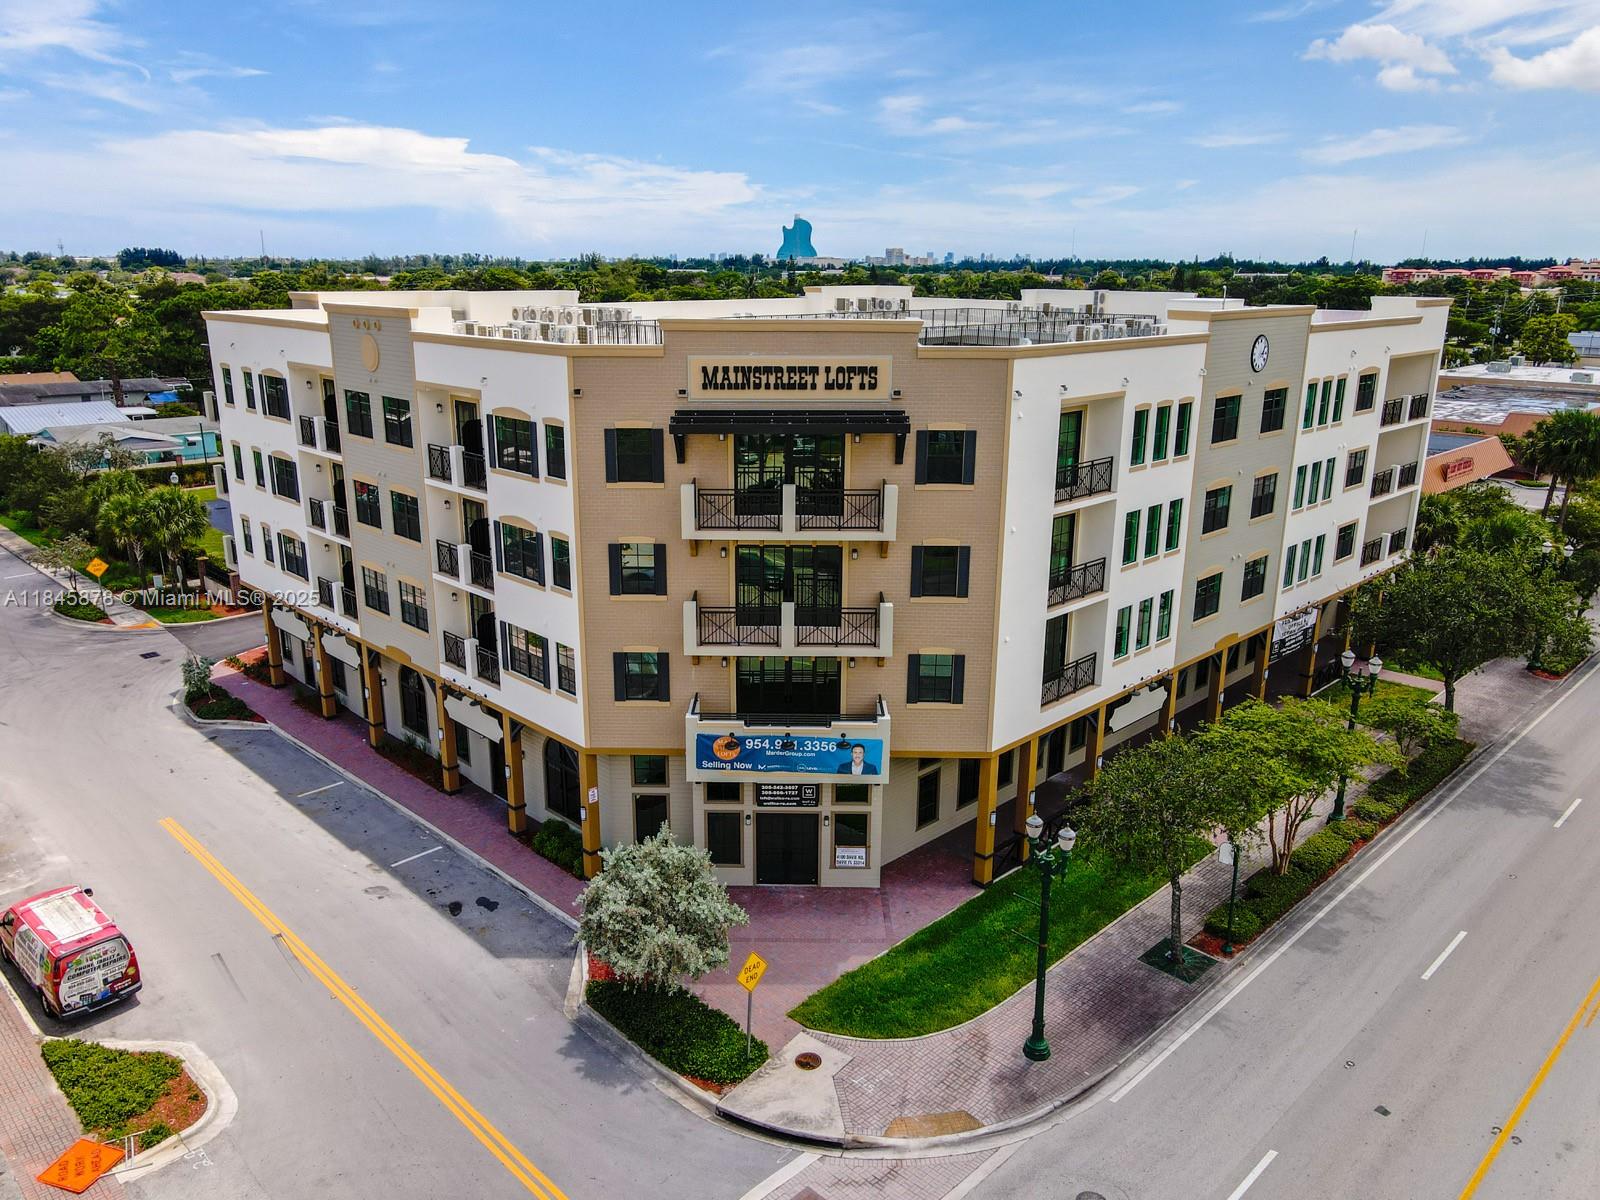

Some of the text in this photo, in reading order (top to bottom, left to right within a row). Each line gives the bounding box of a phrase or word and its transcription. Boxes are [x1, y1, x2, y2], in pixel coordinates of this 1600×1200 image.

[701, 365, 878, 390] MAINSTREET LOFTS
[745, 739, 837, 752] 954.91.3356
[702, 760, 731, 770] Selling
[744, 961, 760, 974] DEAD
[746, 972, 758, 983] END
